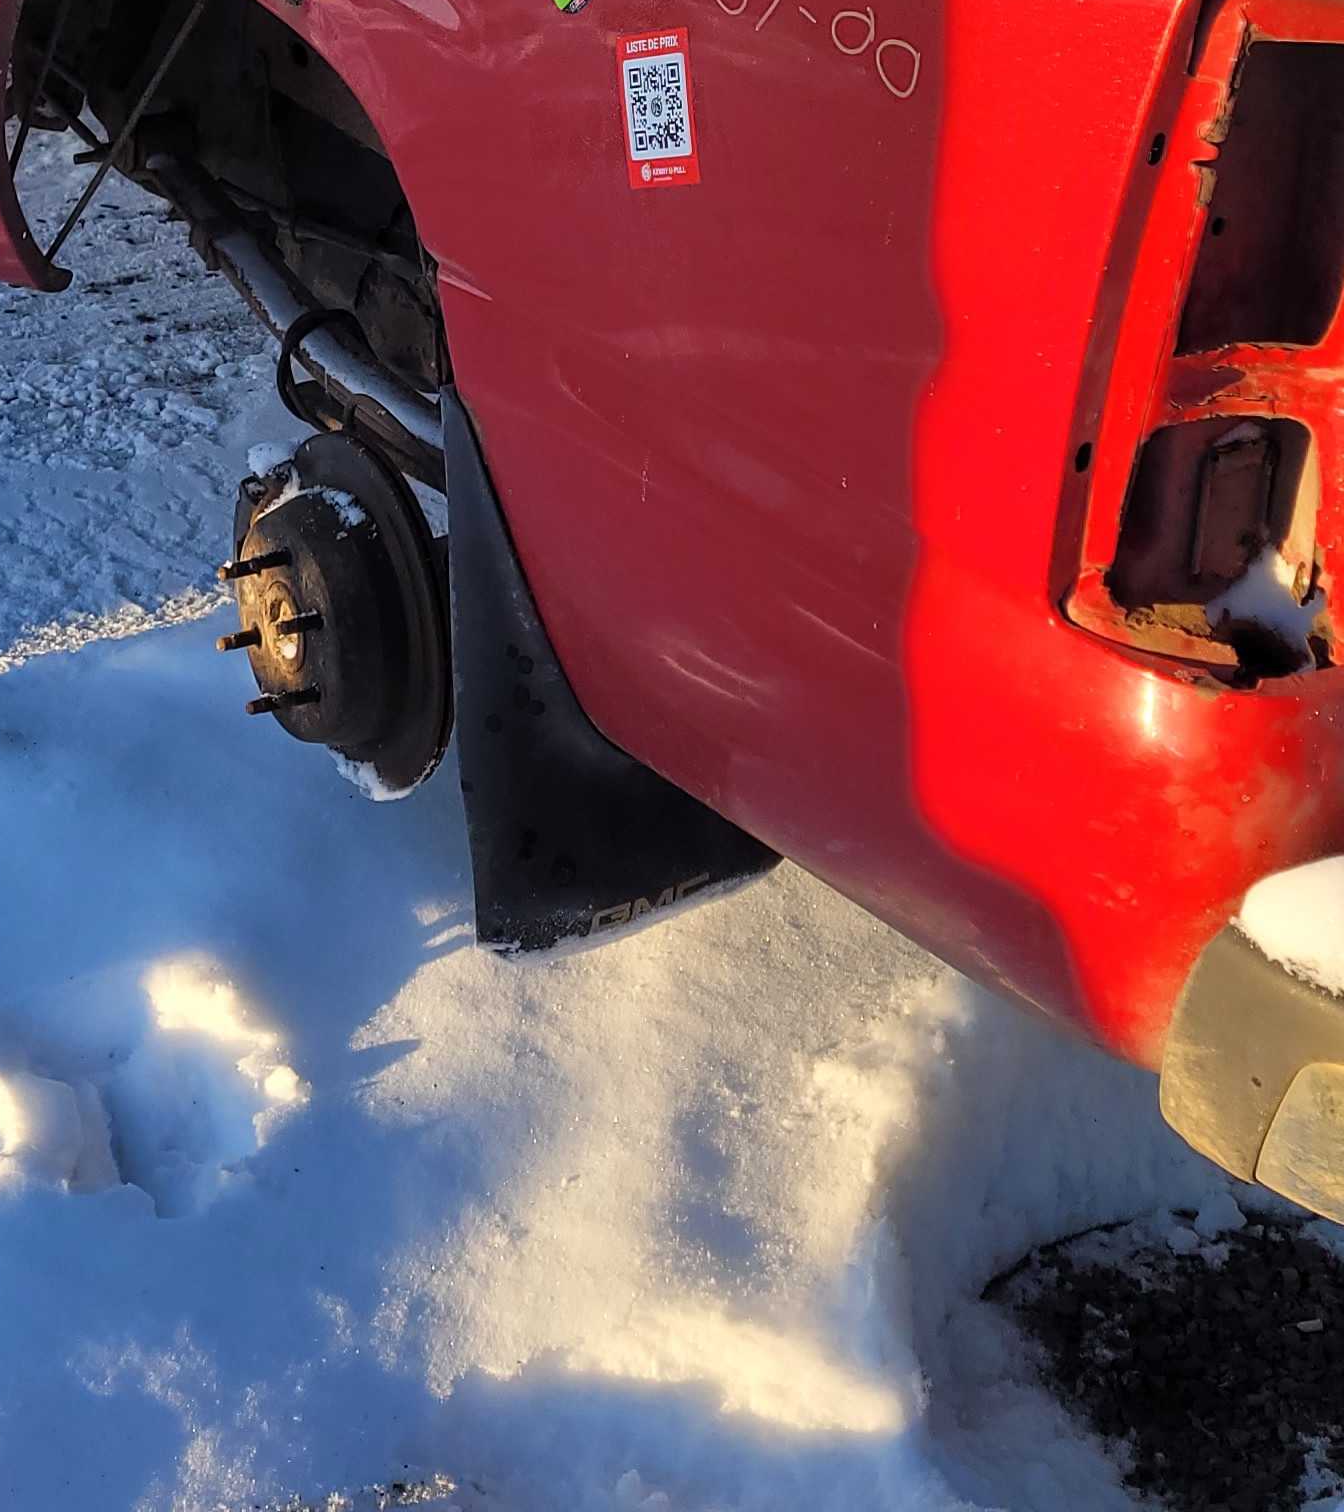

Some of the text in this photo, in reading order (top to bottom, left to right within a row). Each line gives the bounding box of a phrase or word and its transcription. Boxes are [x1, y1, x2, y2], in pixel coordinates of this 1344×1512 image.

[626, 33, 679, 53] LISTE DE PRIX
